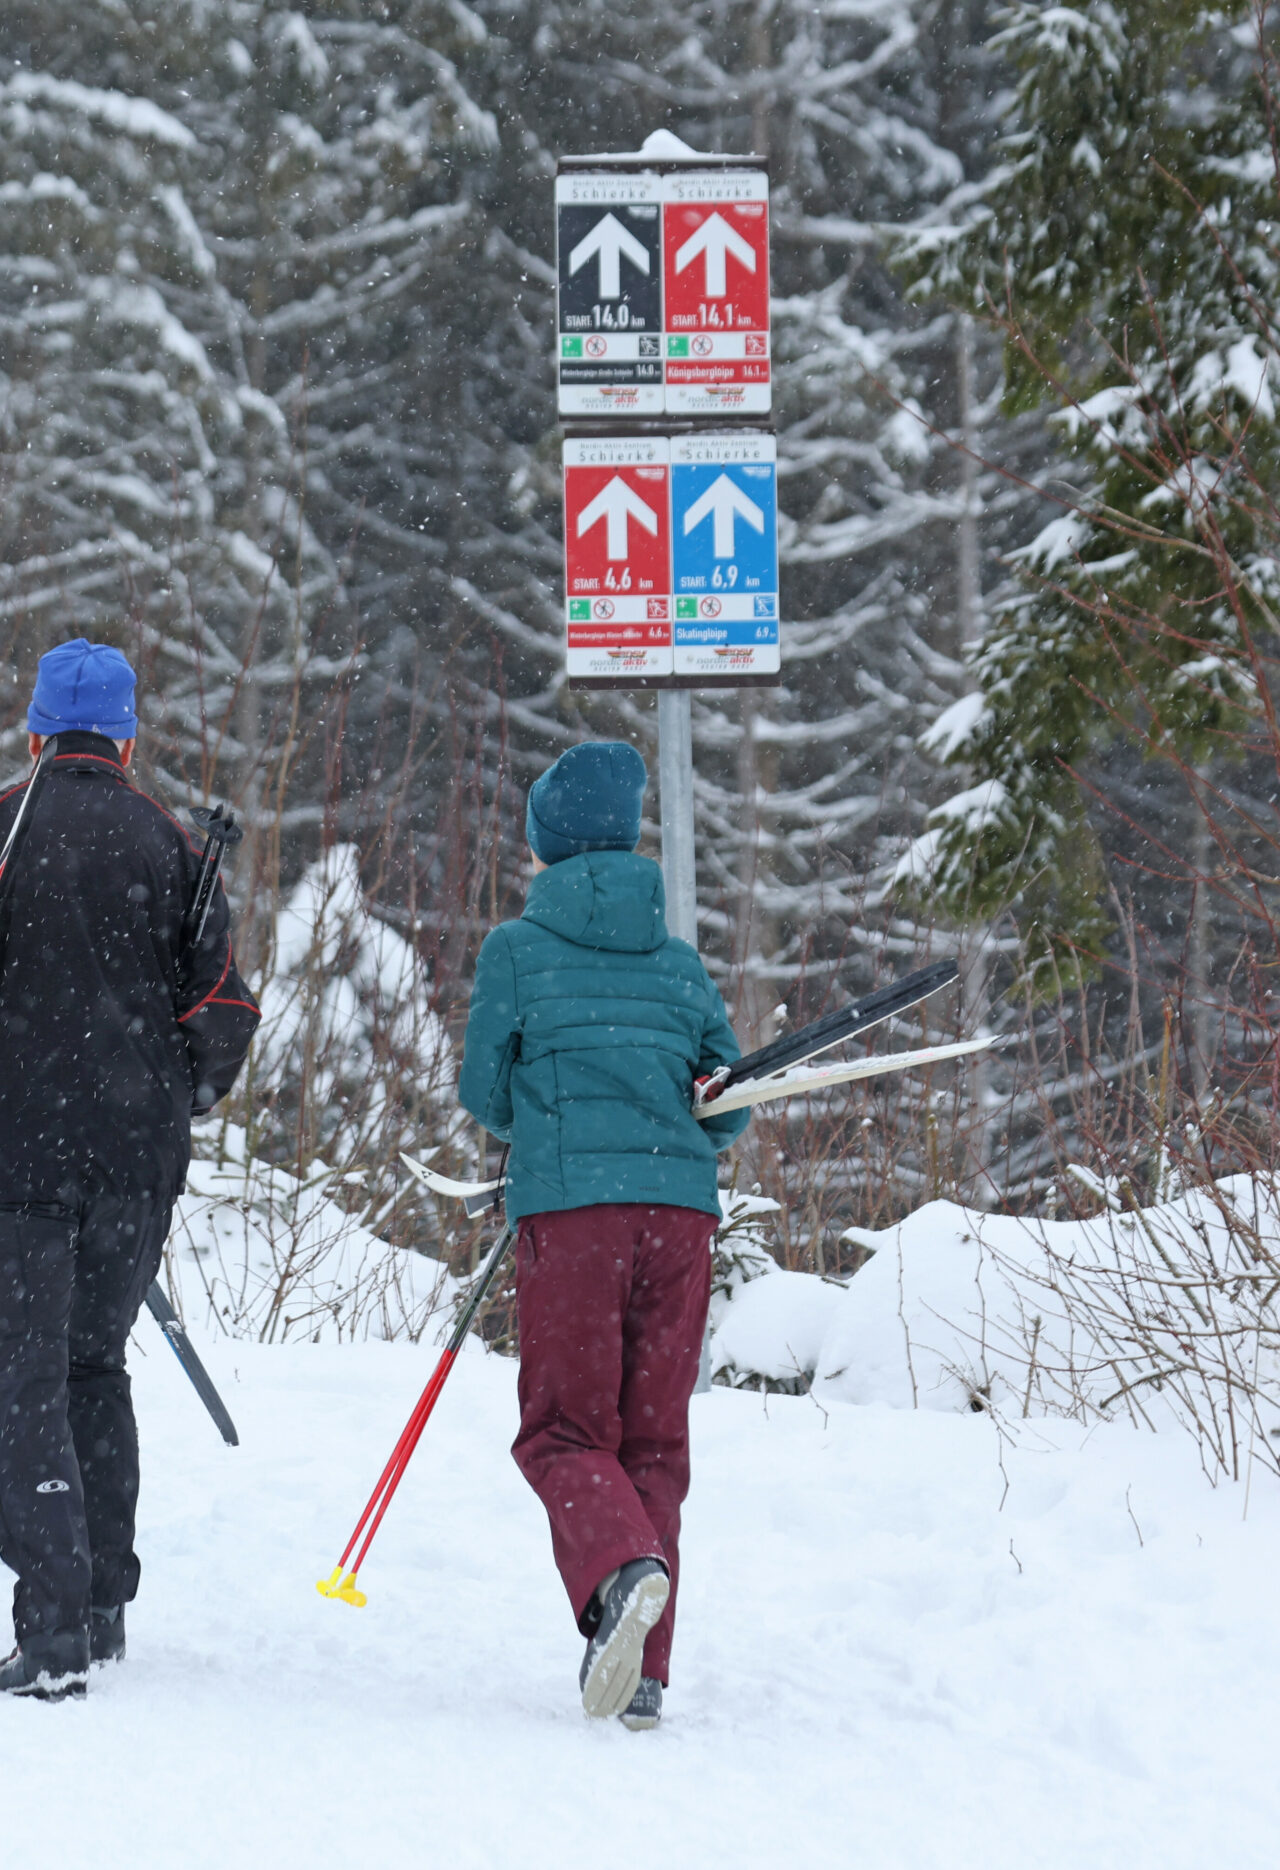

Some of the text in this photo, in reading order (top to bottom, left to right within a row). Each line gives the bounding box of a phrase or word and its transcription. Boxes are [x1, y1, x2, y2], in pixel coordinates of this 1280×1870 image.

[572, 187, 646, 199] Schierke
[678, 186, 752, 198] Schierke
[565, 304, 645, 327] START: 14,0 km
[672, 303, 752, 327] START: 14,1 km
[668, 365, 735, 379] Königsbergloipe
[614, 396, 640, 404] aktiv
[720, 395, 746, 403] aktiv
[579, 450, 654, 462] Schierke
[686, 448, 761, 460] Schierke
[574, 567, 654, 591] START: 4,6 km
[680, 565, 760, 589] START: 6,9 km
[677, 628, 728, 641] Skatingloipe
[622, 658, 648, 666] aktiv
[729, 656, 755, 664] aktiv
